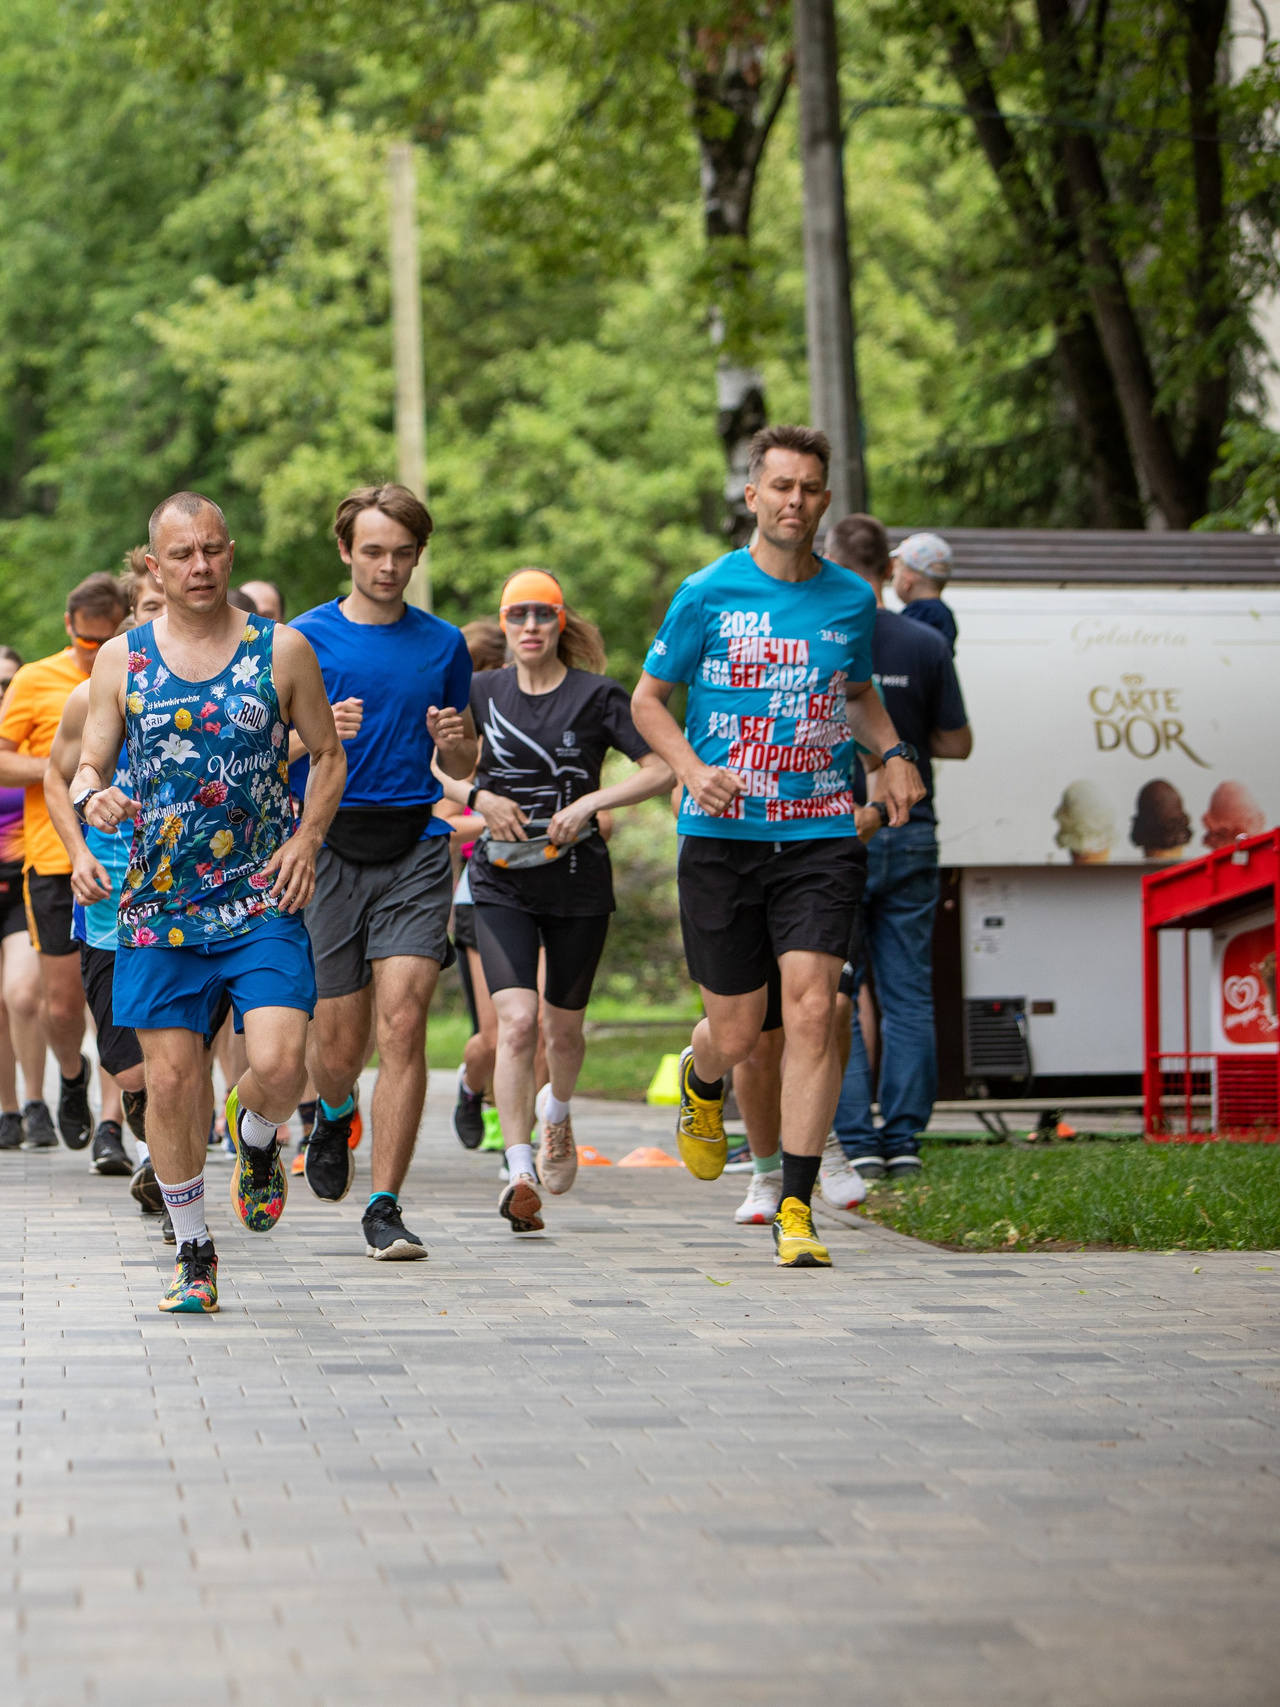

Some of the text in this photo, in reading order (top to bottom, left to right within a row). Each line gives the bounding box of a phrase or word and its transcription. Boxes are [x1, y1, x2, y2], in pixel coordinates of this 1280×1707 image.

[719, 611, 773, 638] 2024
[727, 637, 810, 666] #МЕЧТА
[702, 656, 820, 692] #ЗАБЕГ2024
[1088, 684, 1182, 717] CARTE
[145, 716, 163, 727] KRB
[707, 711, 777, 744] #ЗАБЕГ
[726, 741, 834, 773] #ГОРДОСТЬ
